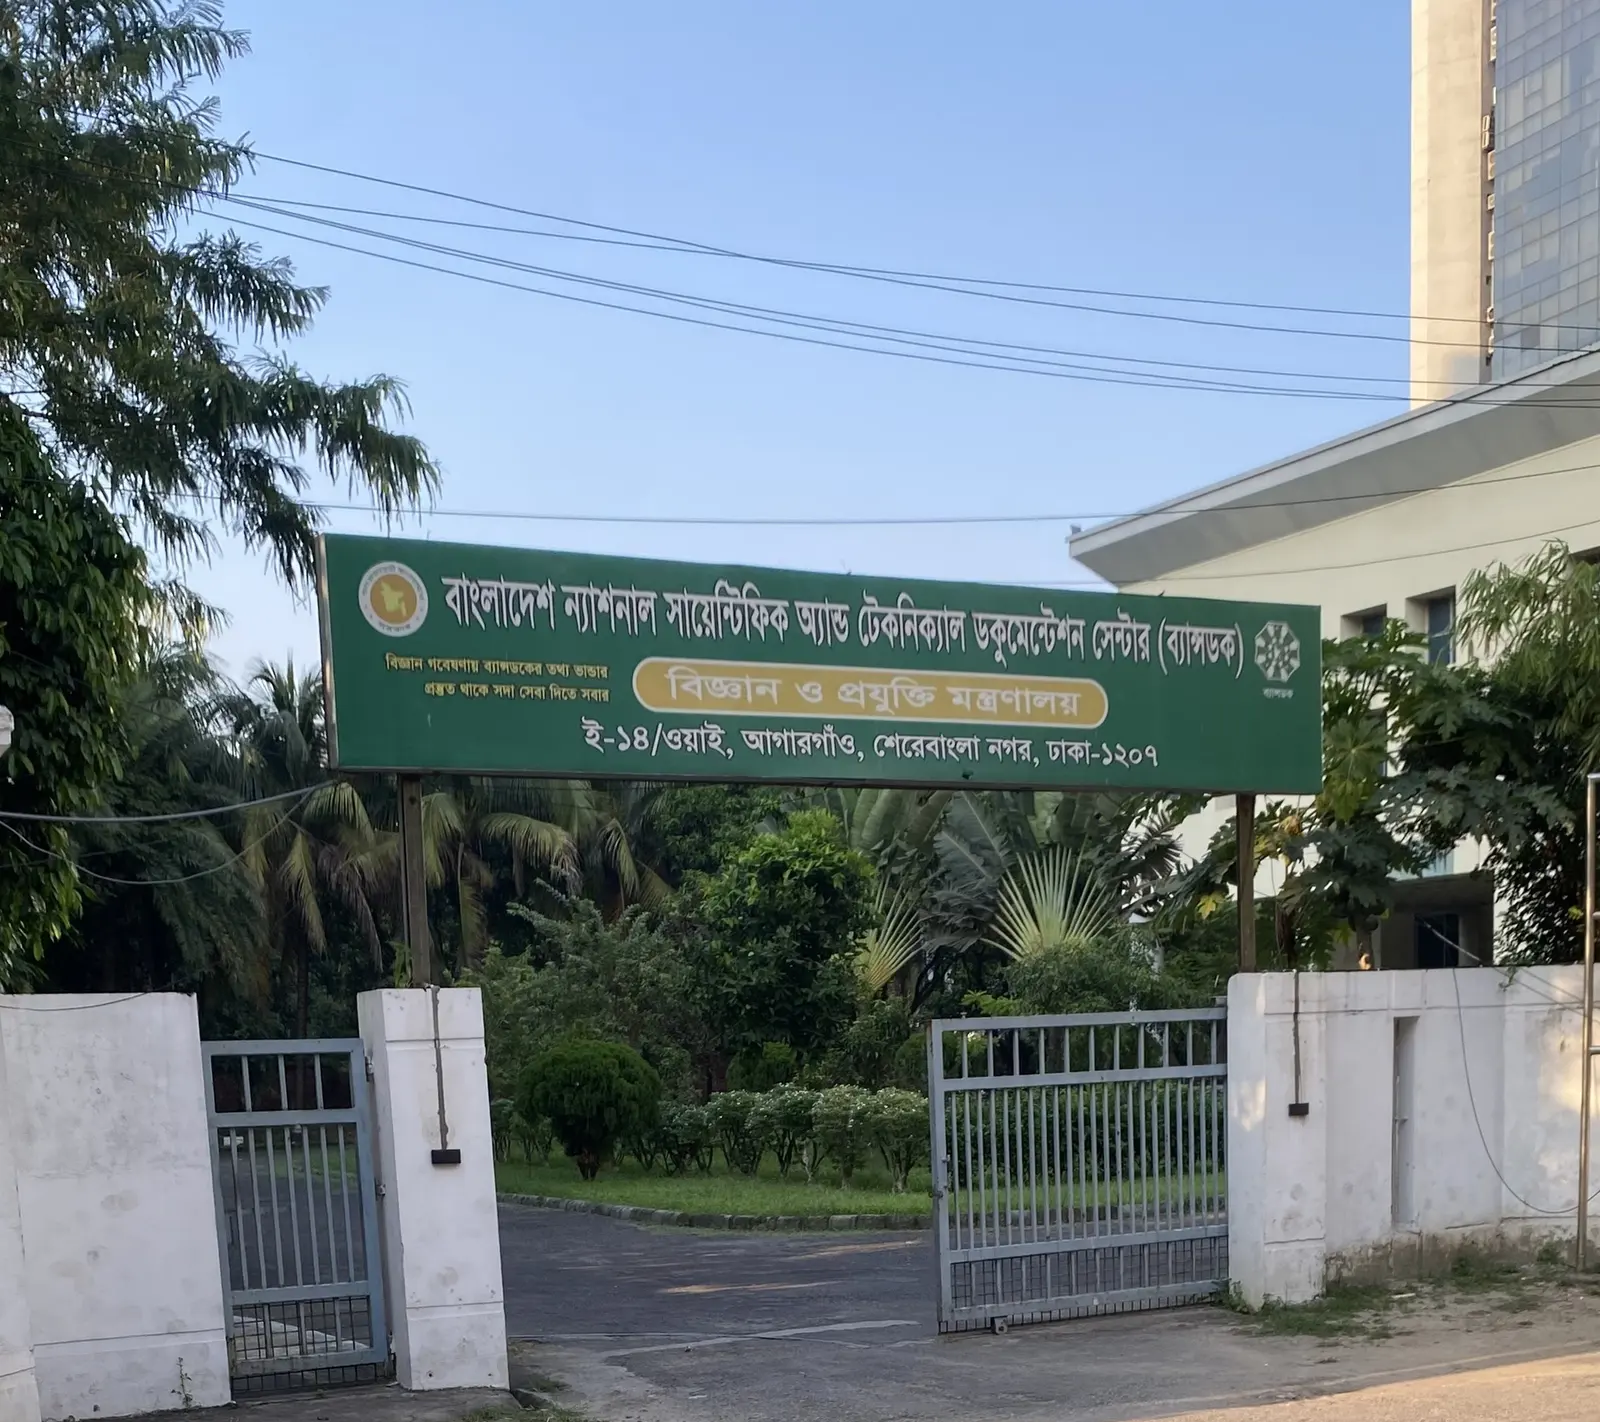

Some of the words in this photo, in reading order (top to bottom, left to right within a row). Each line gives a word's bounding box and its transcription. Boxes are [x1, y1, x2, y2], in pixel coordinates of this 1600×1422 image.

[441, 572, 556, 631] বাংলাদেশ
[560, 581, 658, 636] ন্যাশনাল
[663, 578, 789, 643] সায়েন্টিফিক
[795, 597, 850, 647] অ্যান্ড
[858, 589, 966, 653] টেকনিক্যাল
[972, 602, 1085, 669] ডকুমেন্টেশন
[1092, 607, 1151, 662] সেন্টার
[385, 652, 423, 671] বিজ্ঞান
[665, 665, 782, 705] বিজ্ঞান
[795, 681, 823, 705] ও
[838, 676, 937, 715] প্রযুক্তি
[946, 686, 1082, 717] মন্ত্রণালয়
[740, 724, 865, 763] আগারগাঁও,
[873, 732, 981, 763] শেরেবাংলা
[986, 737, 1040, 768] নগর,
[1046, 738, 1159, 769] ঢাকা-১২০৭
